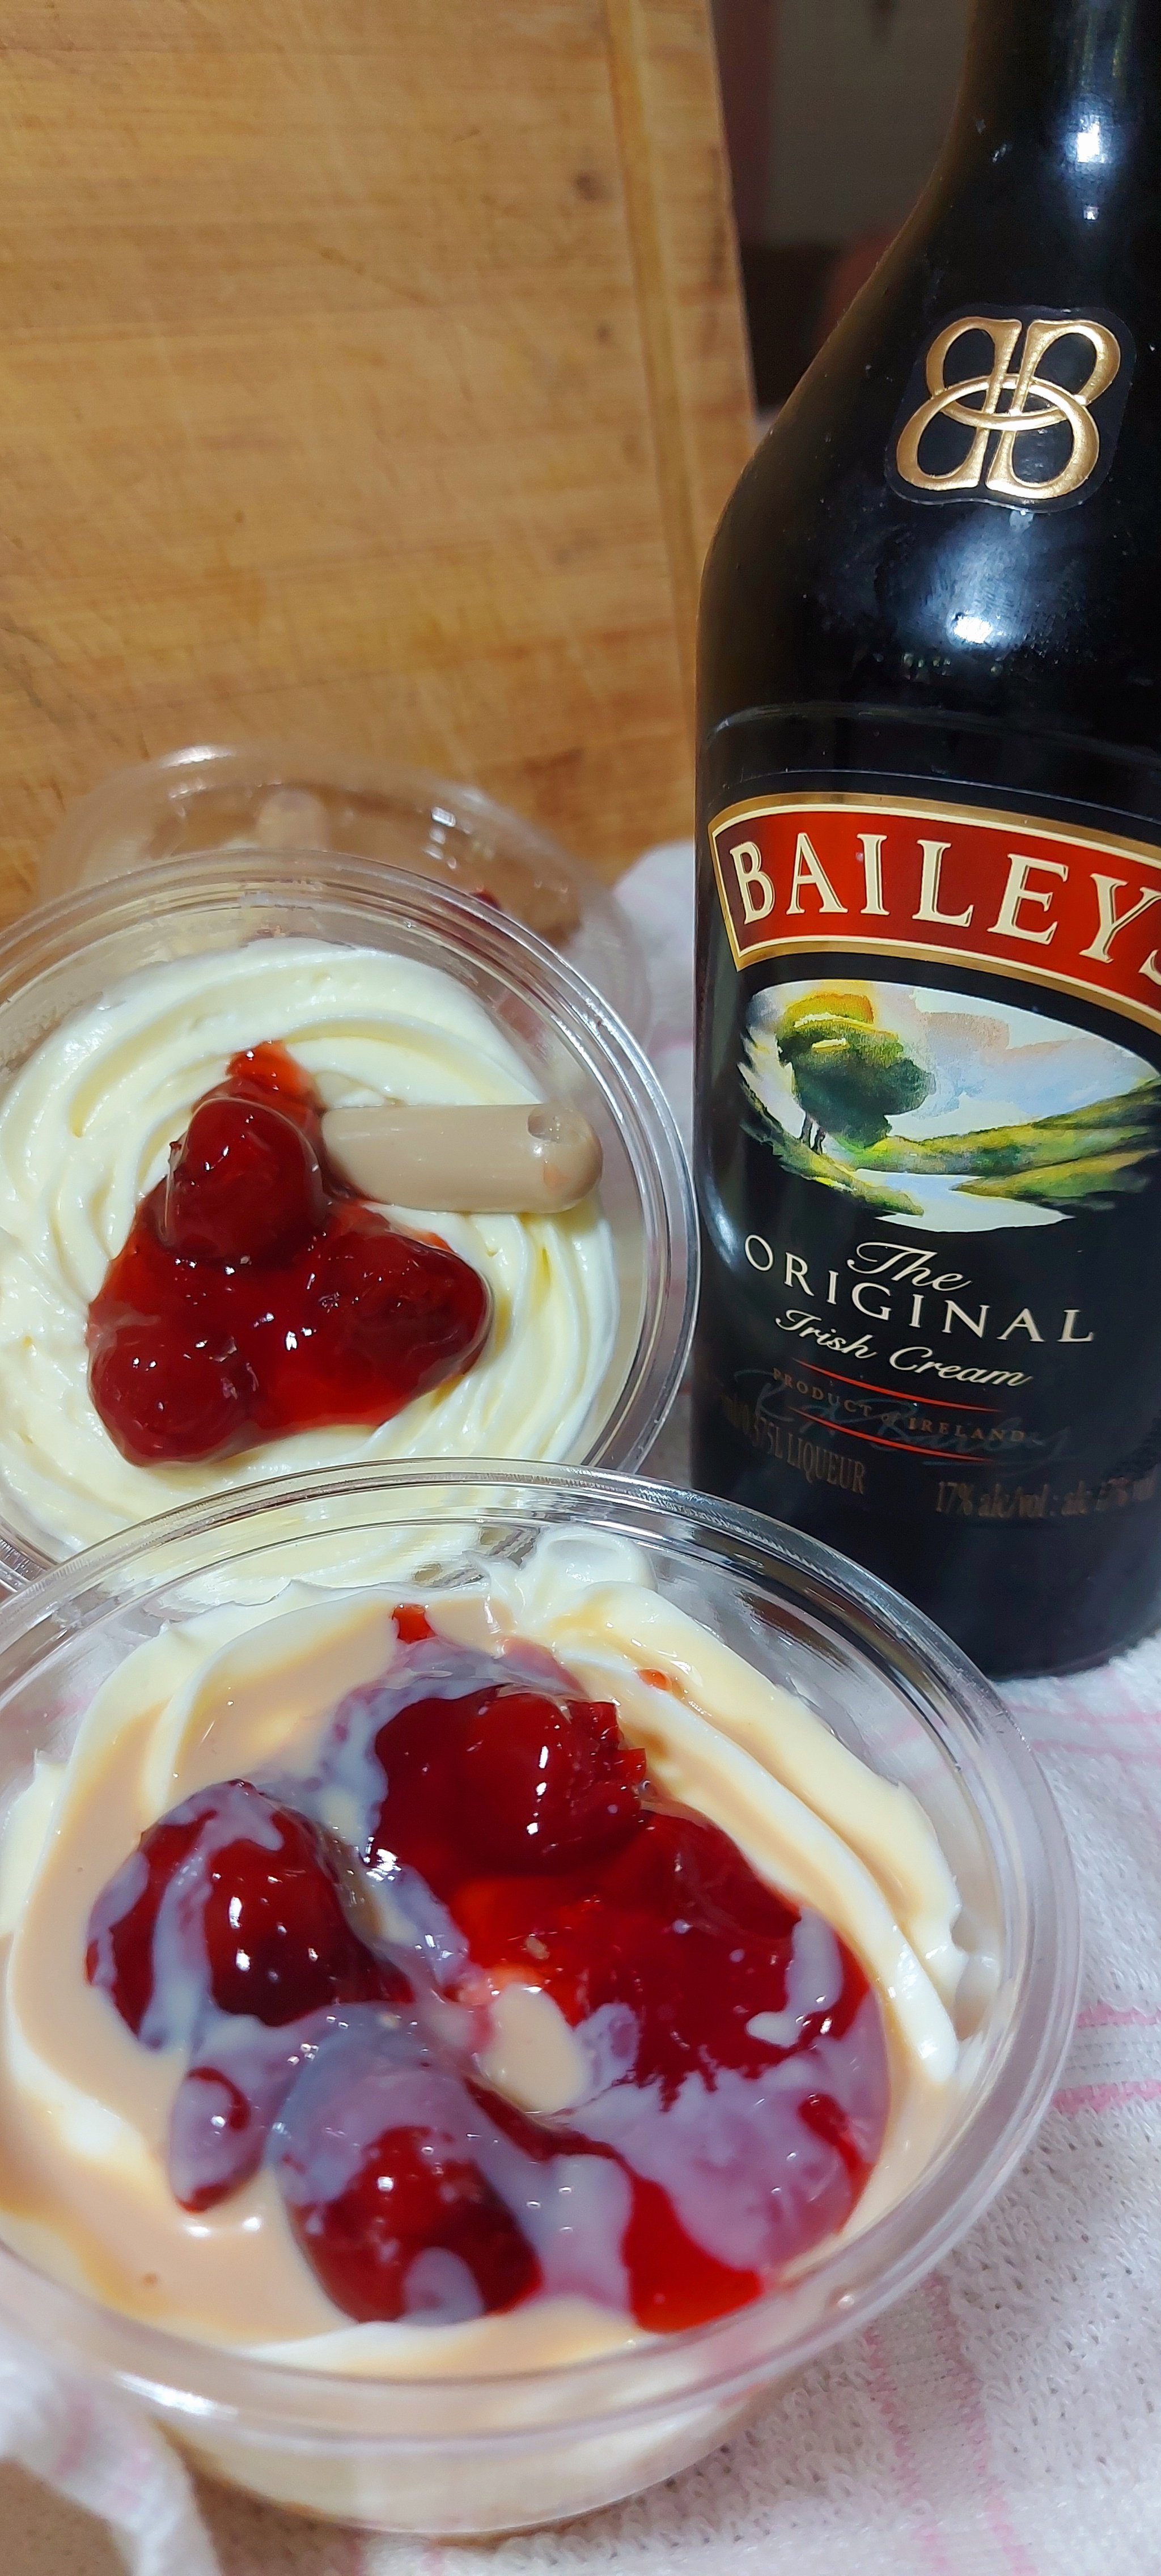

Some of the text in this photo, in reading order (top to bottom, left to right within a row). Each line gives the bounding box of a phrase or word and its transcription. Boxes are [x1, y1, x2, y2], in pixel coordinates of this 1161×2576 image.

[744, 1234, 1095, 1344] ORIGINAL
[846, 1241, 972, 1291] The
[775, 1308, 1035, 1387] Irish Cream
[773, 1367, 872, 1417] PRODUCT
[908, 1416, 1026, 1442] IRELAND
[787, 1433, 866, 1495] LIQUEUR
